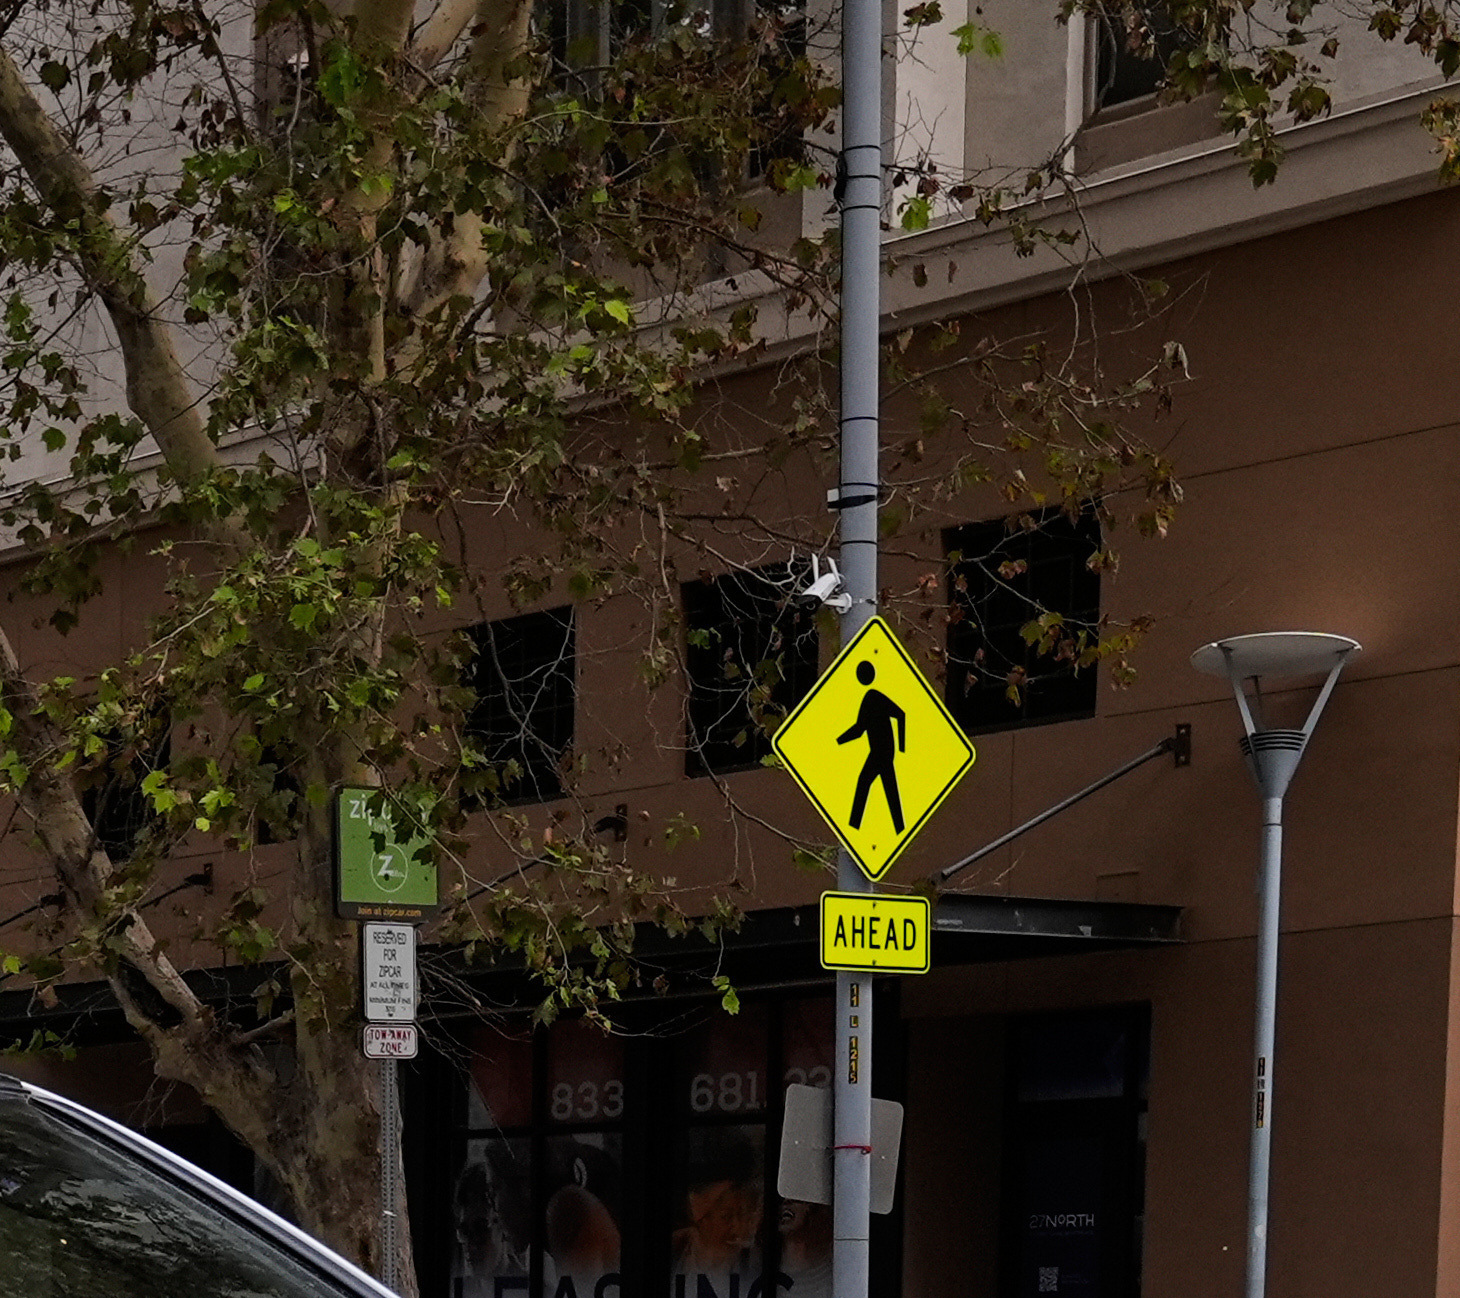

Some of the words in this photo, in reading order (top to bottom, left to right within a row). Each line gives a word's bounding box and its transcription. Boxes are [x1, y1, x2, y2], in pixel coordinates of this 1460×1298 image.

[373, 932, 407, 945] RESERVED
[832, 914, 917, 951] AHEAD
[383, 949, 397, 961] FOR
[379, 966, 402, 978] ZIPCAR
[370, 1029, 412, 1041] TOW-AWAY
[380, 1042, 402, 1053] ZONE
[849, 1037, 858, 1084] 1215
[551, 1079, 624, 1120] 833
